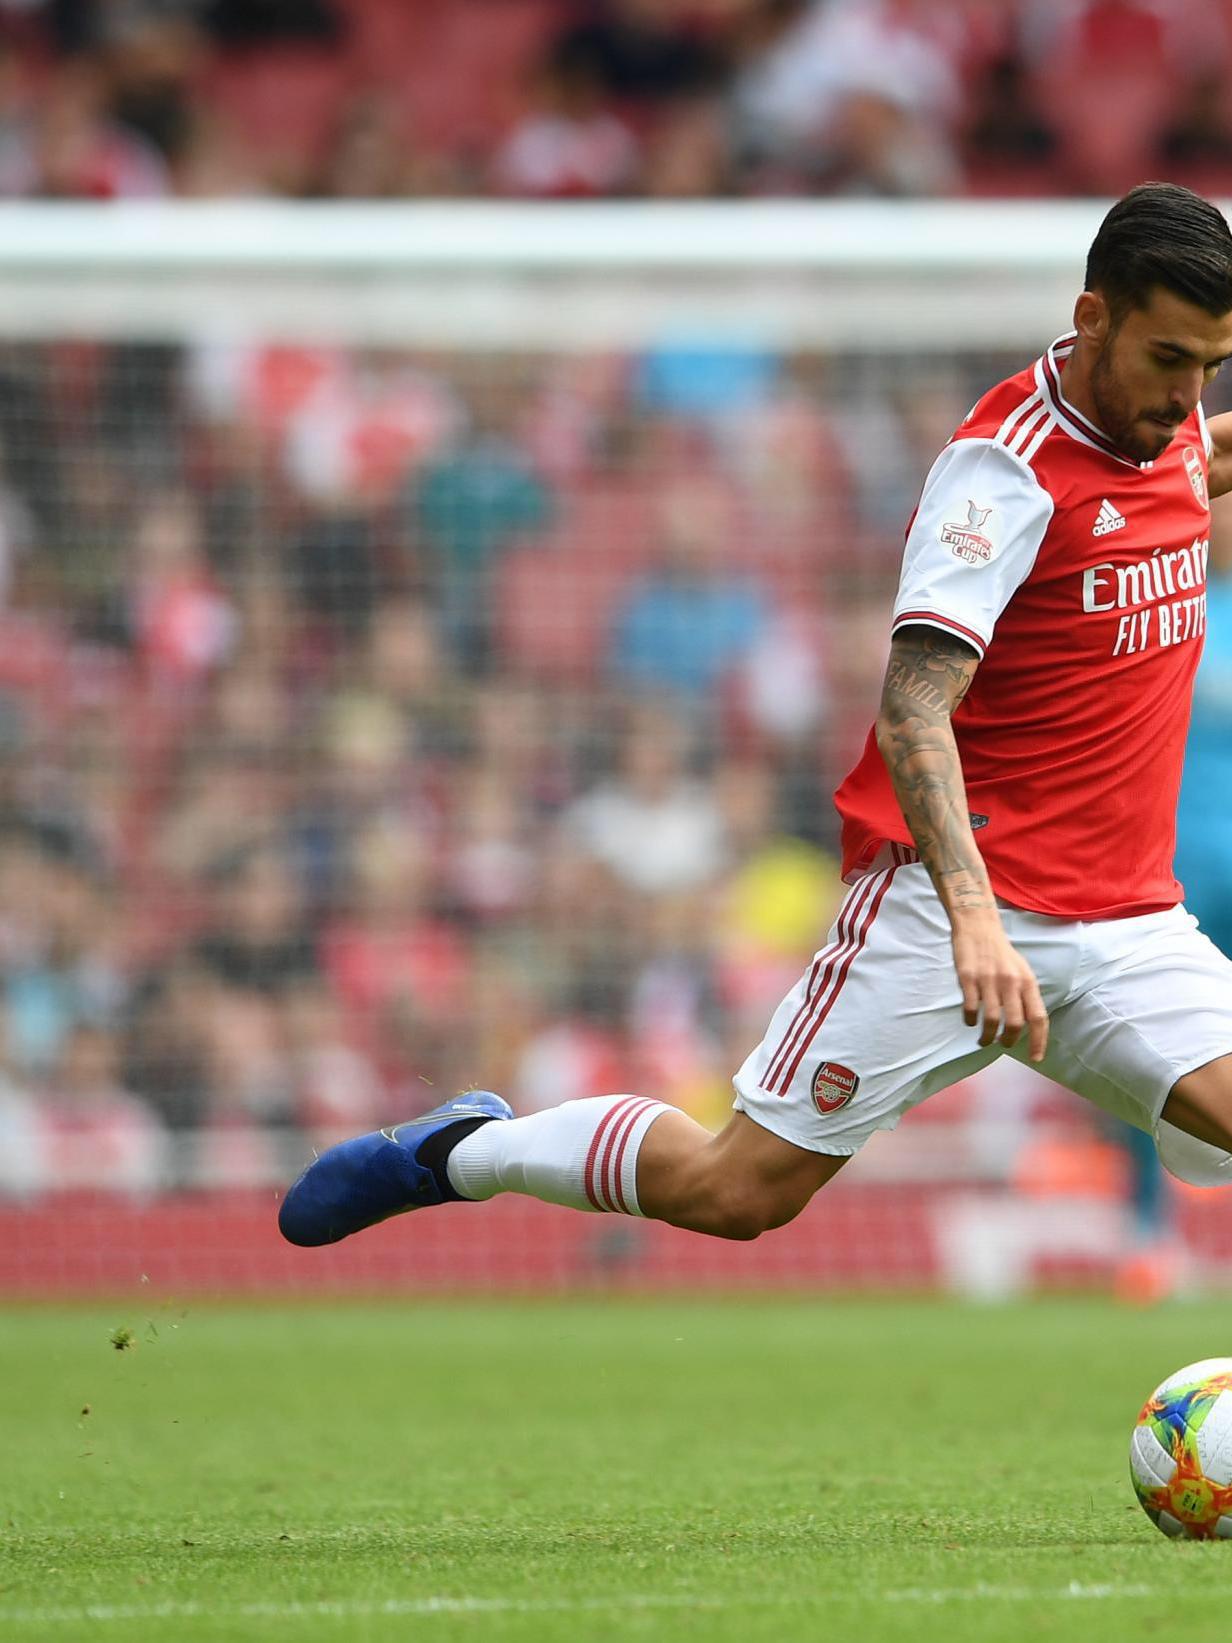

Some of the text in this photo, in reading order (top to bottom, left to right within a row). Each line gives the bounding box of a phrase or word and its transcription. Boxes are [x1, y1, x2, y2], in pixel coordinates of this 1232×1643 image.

[1092, 516, 1126, 537] adidas
[941, 530, 990, 560] Emirates
[953, 544, 977, 563] Cup
[1083, 537, 1209, 613] Emirate
[1112, 609, 1151, 656] FLY
[820, 1068, 853, 1087] Arsenal
